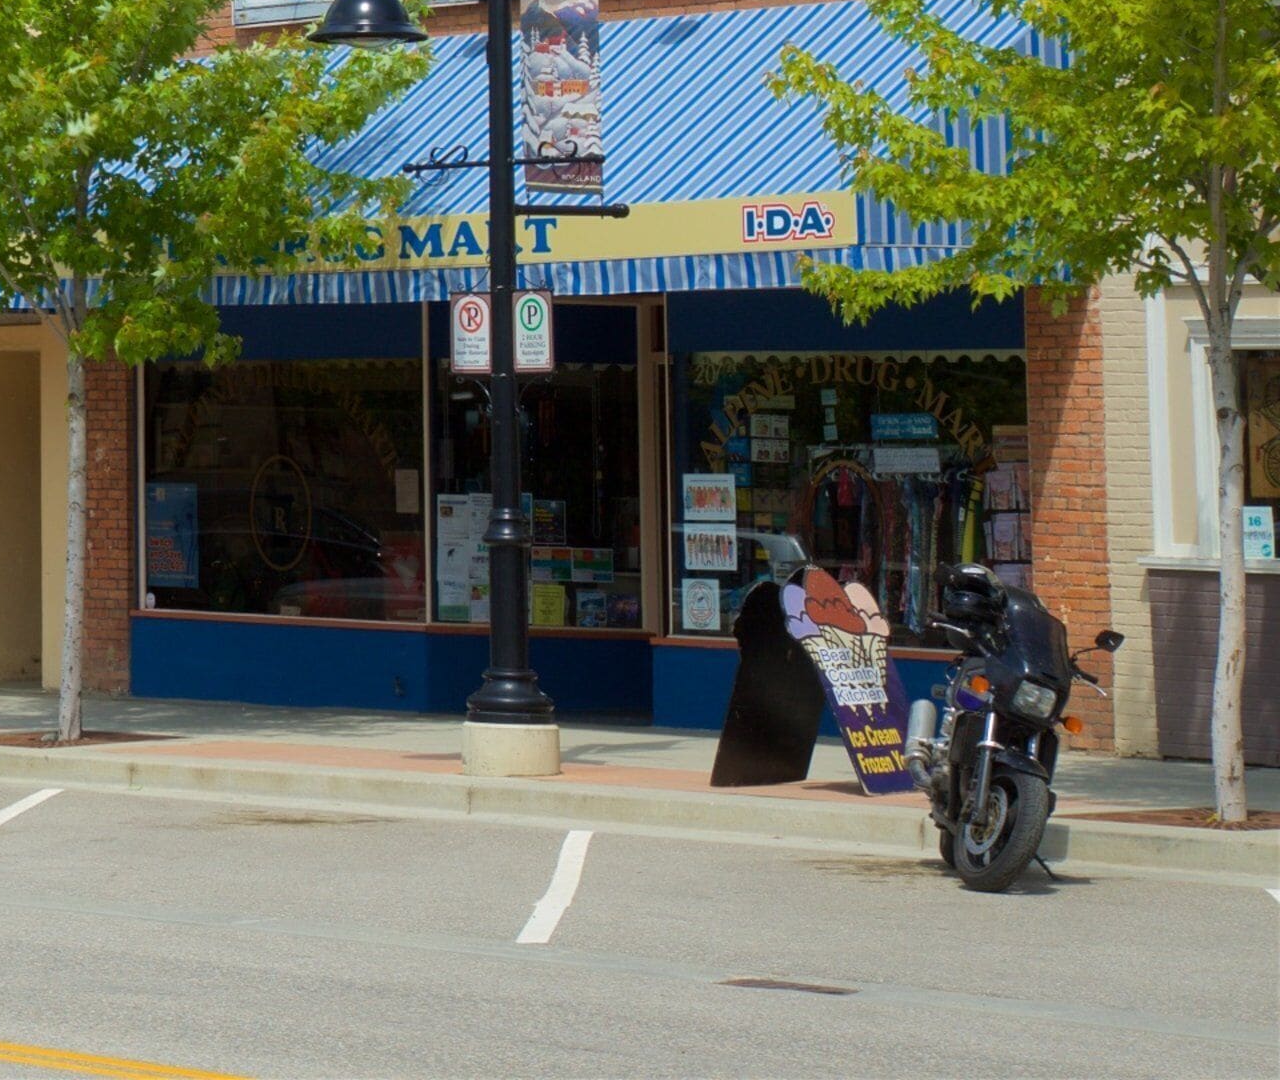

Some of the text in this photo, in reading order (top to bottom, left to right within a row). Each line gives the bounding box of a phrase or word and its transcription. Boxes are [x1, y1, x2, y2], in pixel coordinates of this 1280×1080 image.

[398, 217, 558, 260] MAT
[527, 304, 538, 325] P
[808, 355, 900, 392] DRUG
[819, 648, 850, 663] Bear
[827, 668, 880, 684] Country
[835, 687, 886, 703] Kitchen
[846, 724, 902, 748] Ice Cream
[857, 752, 895, 775] Frozen
